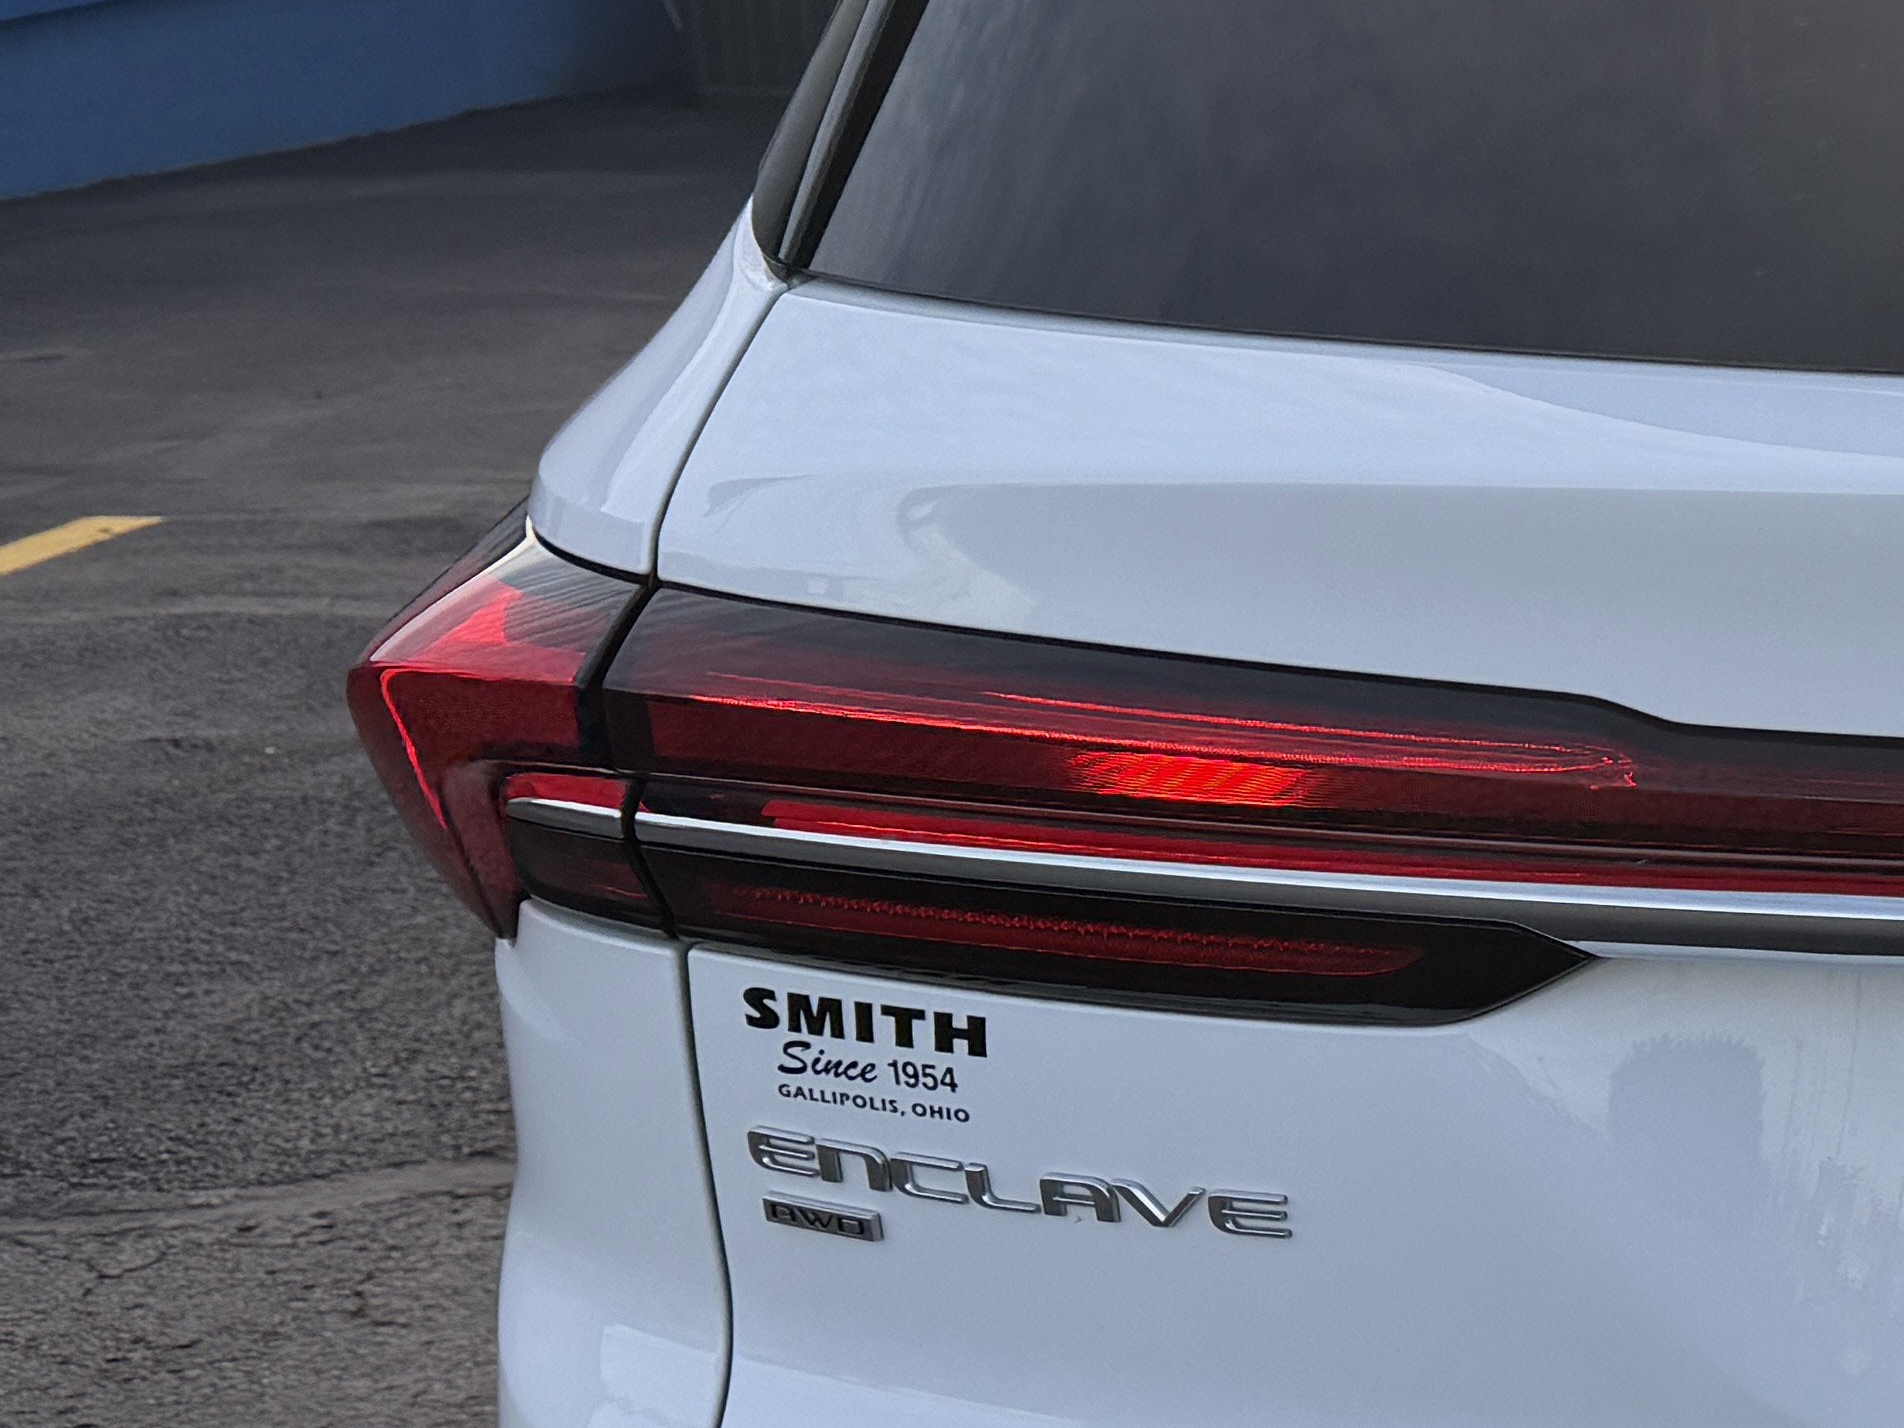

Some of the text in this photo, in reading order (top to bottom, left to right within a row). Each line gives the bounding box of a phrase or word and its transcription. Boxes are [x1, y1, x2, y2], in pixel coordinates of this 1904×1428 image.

[742, 987, 988, 1058] SMITH
[777, 1040, 959, 1093] Since 1954
[777, 1083, 971, 1123] GALLIPOLIS, OHIO
[746, 1125, 1294, 1239] ENCLAVE
[769, 1202, 866, 1236] AWD
